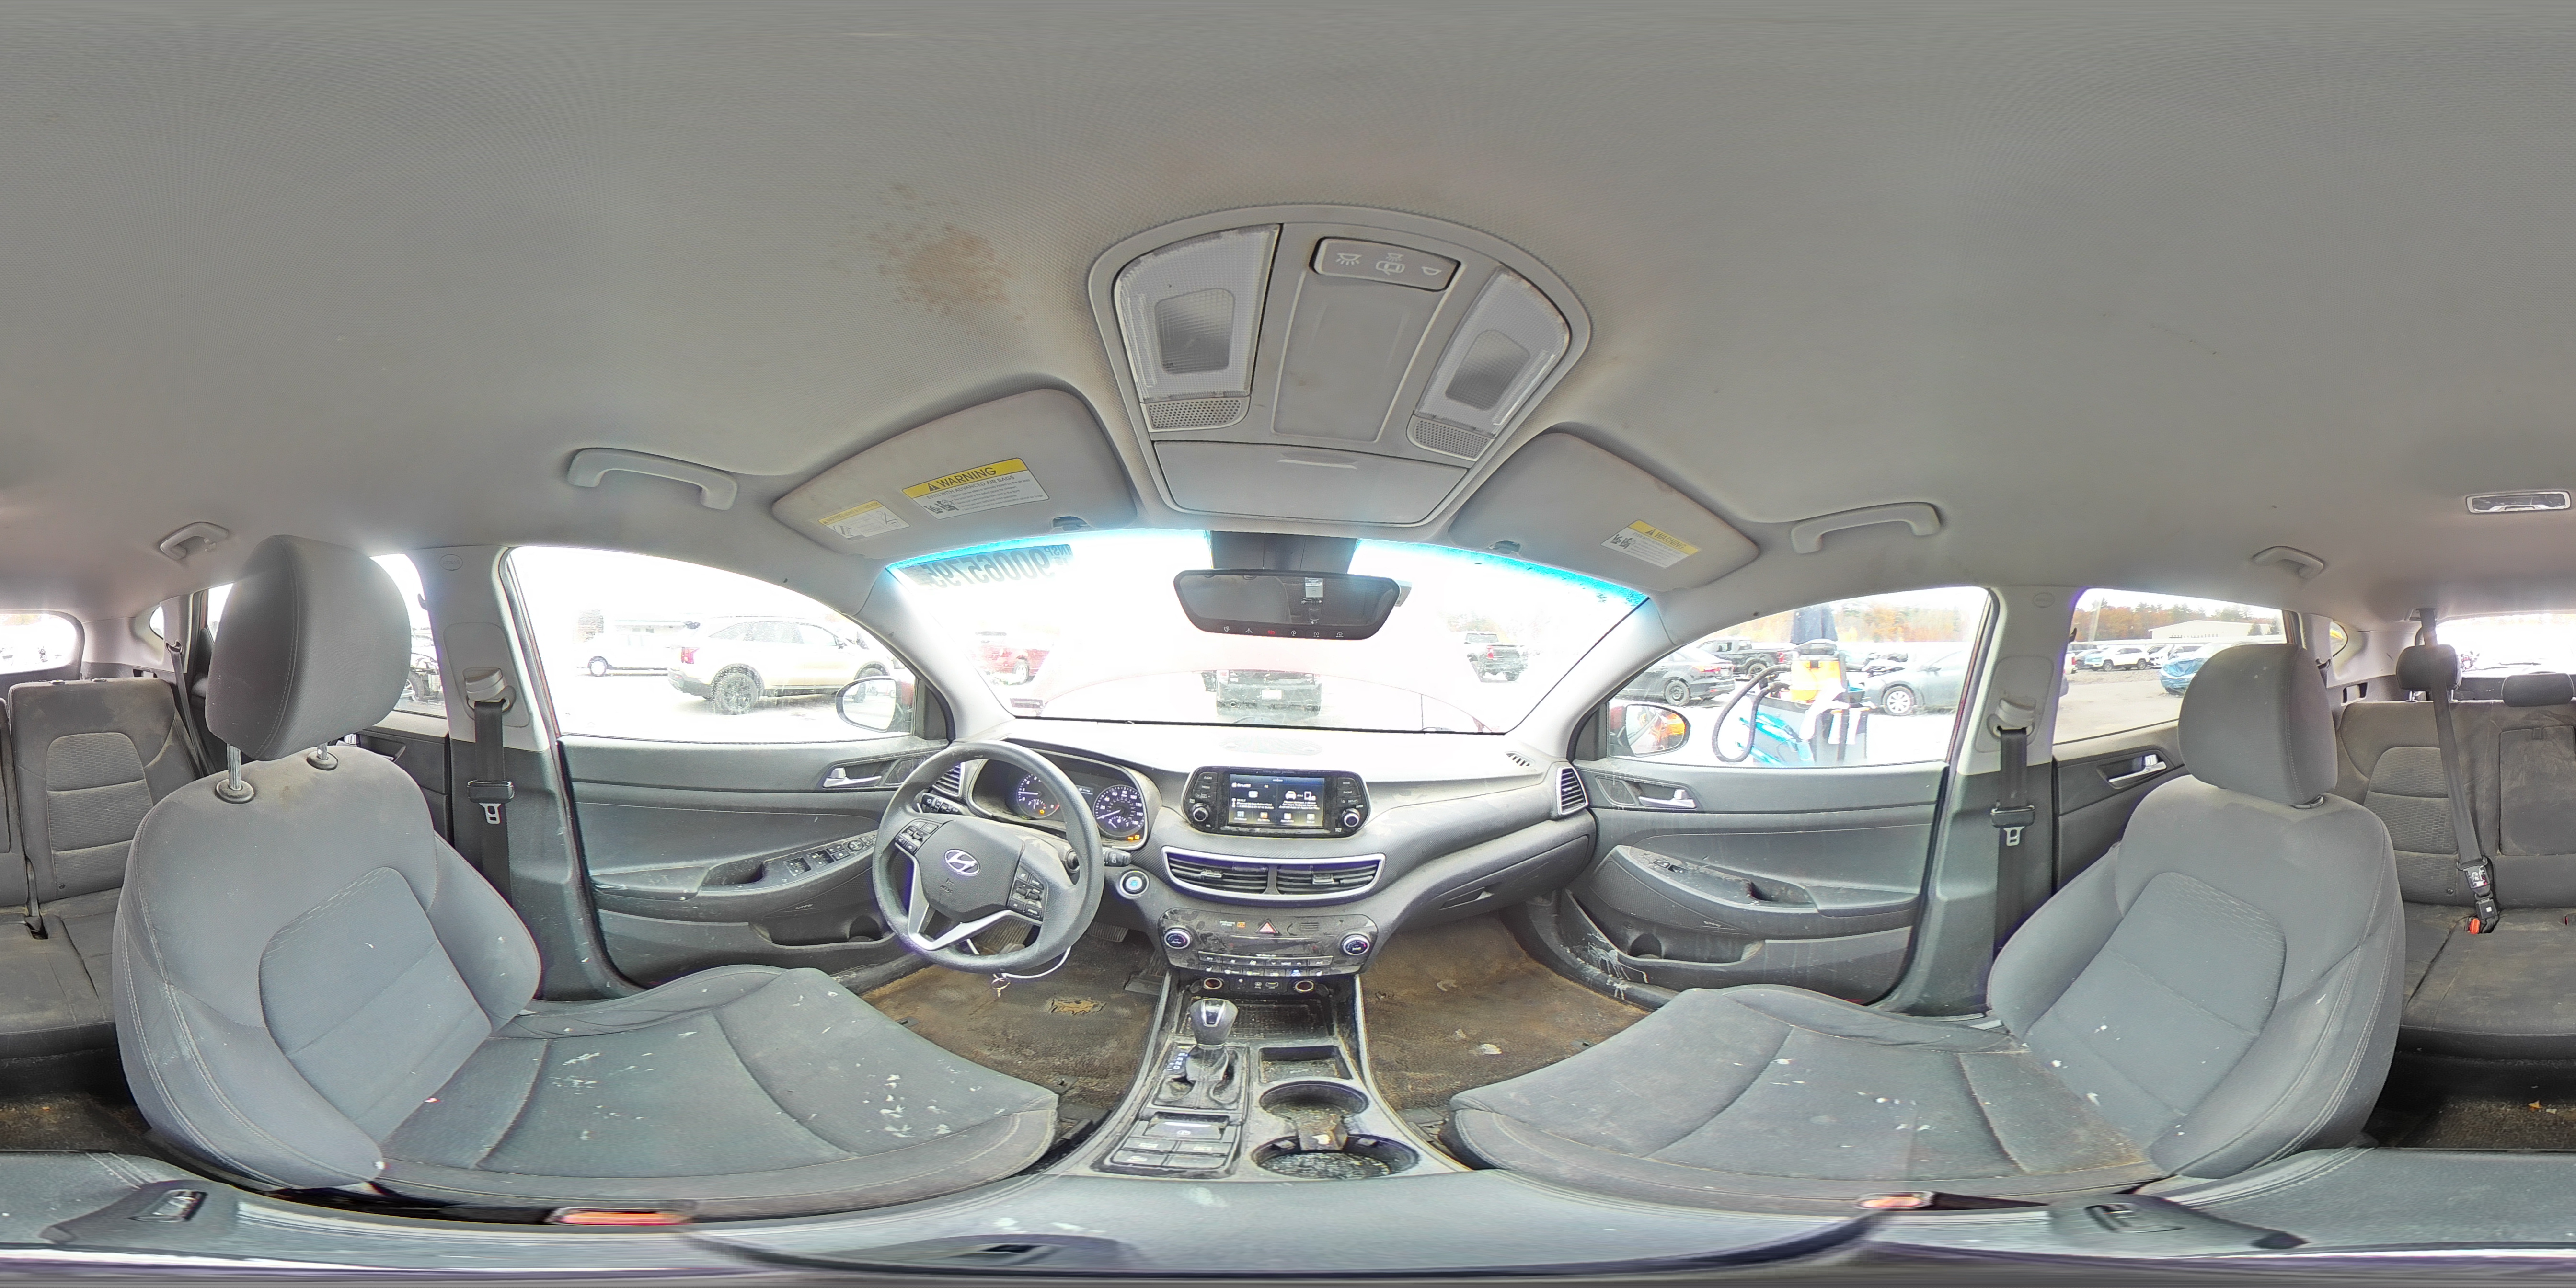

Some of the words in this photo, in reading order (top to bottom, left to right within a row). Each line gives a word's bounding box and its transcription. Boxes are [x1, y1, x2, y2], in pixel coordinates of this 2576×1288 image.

[936, 467, 997, 488] WARNING
[940, 489, 954, 497] WITH
[954, 482, 985, 493] ADVANCED
[1655, 532, 1687, 550] WARNING
